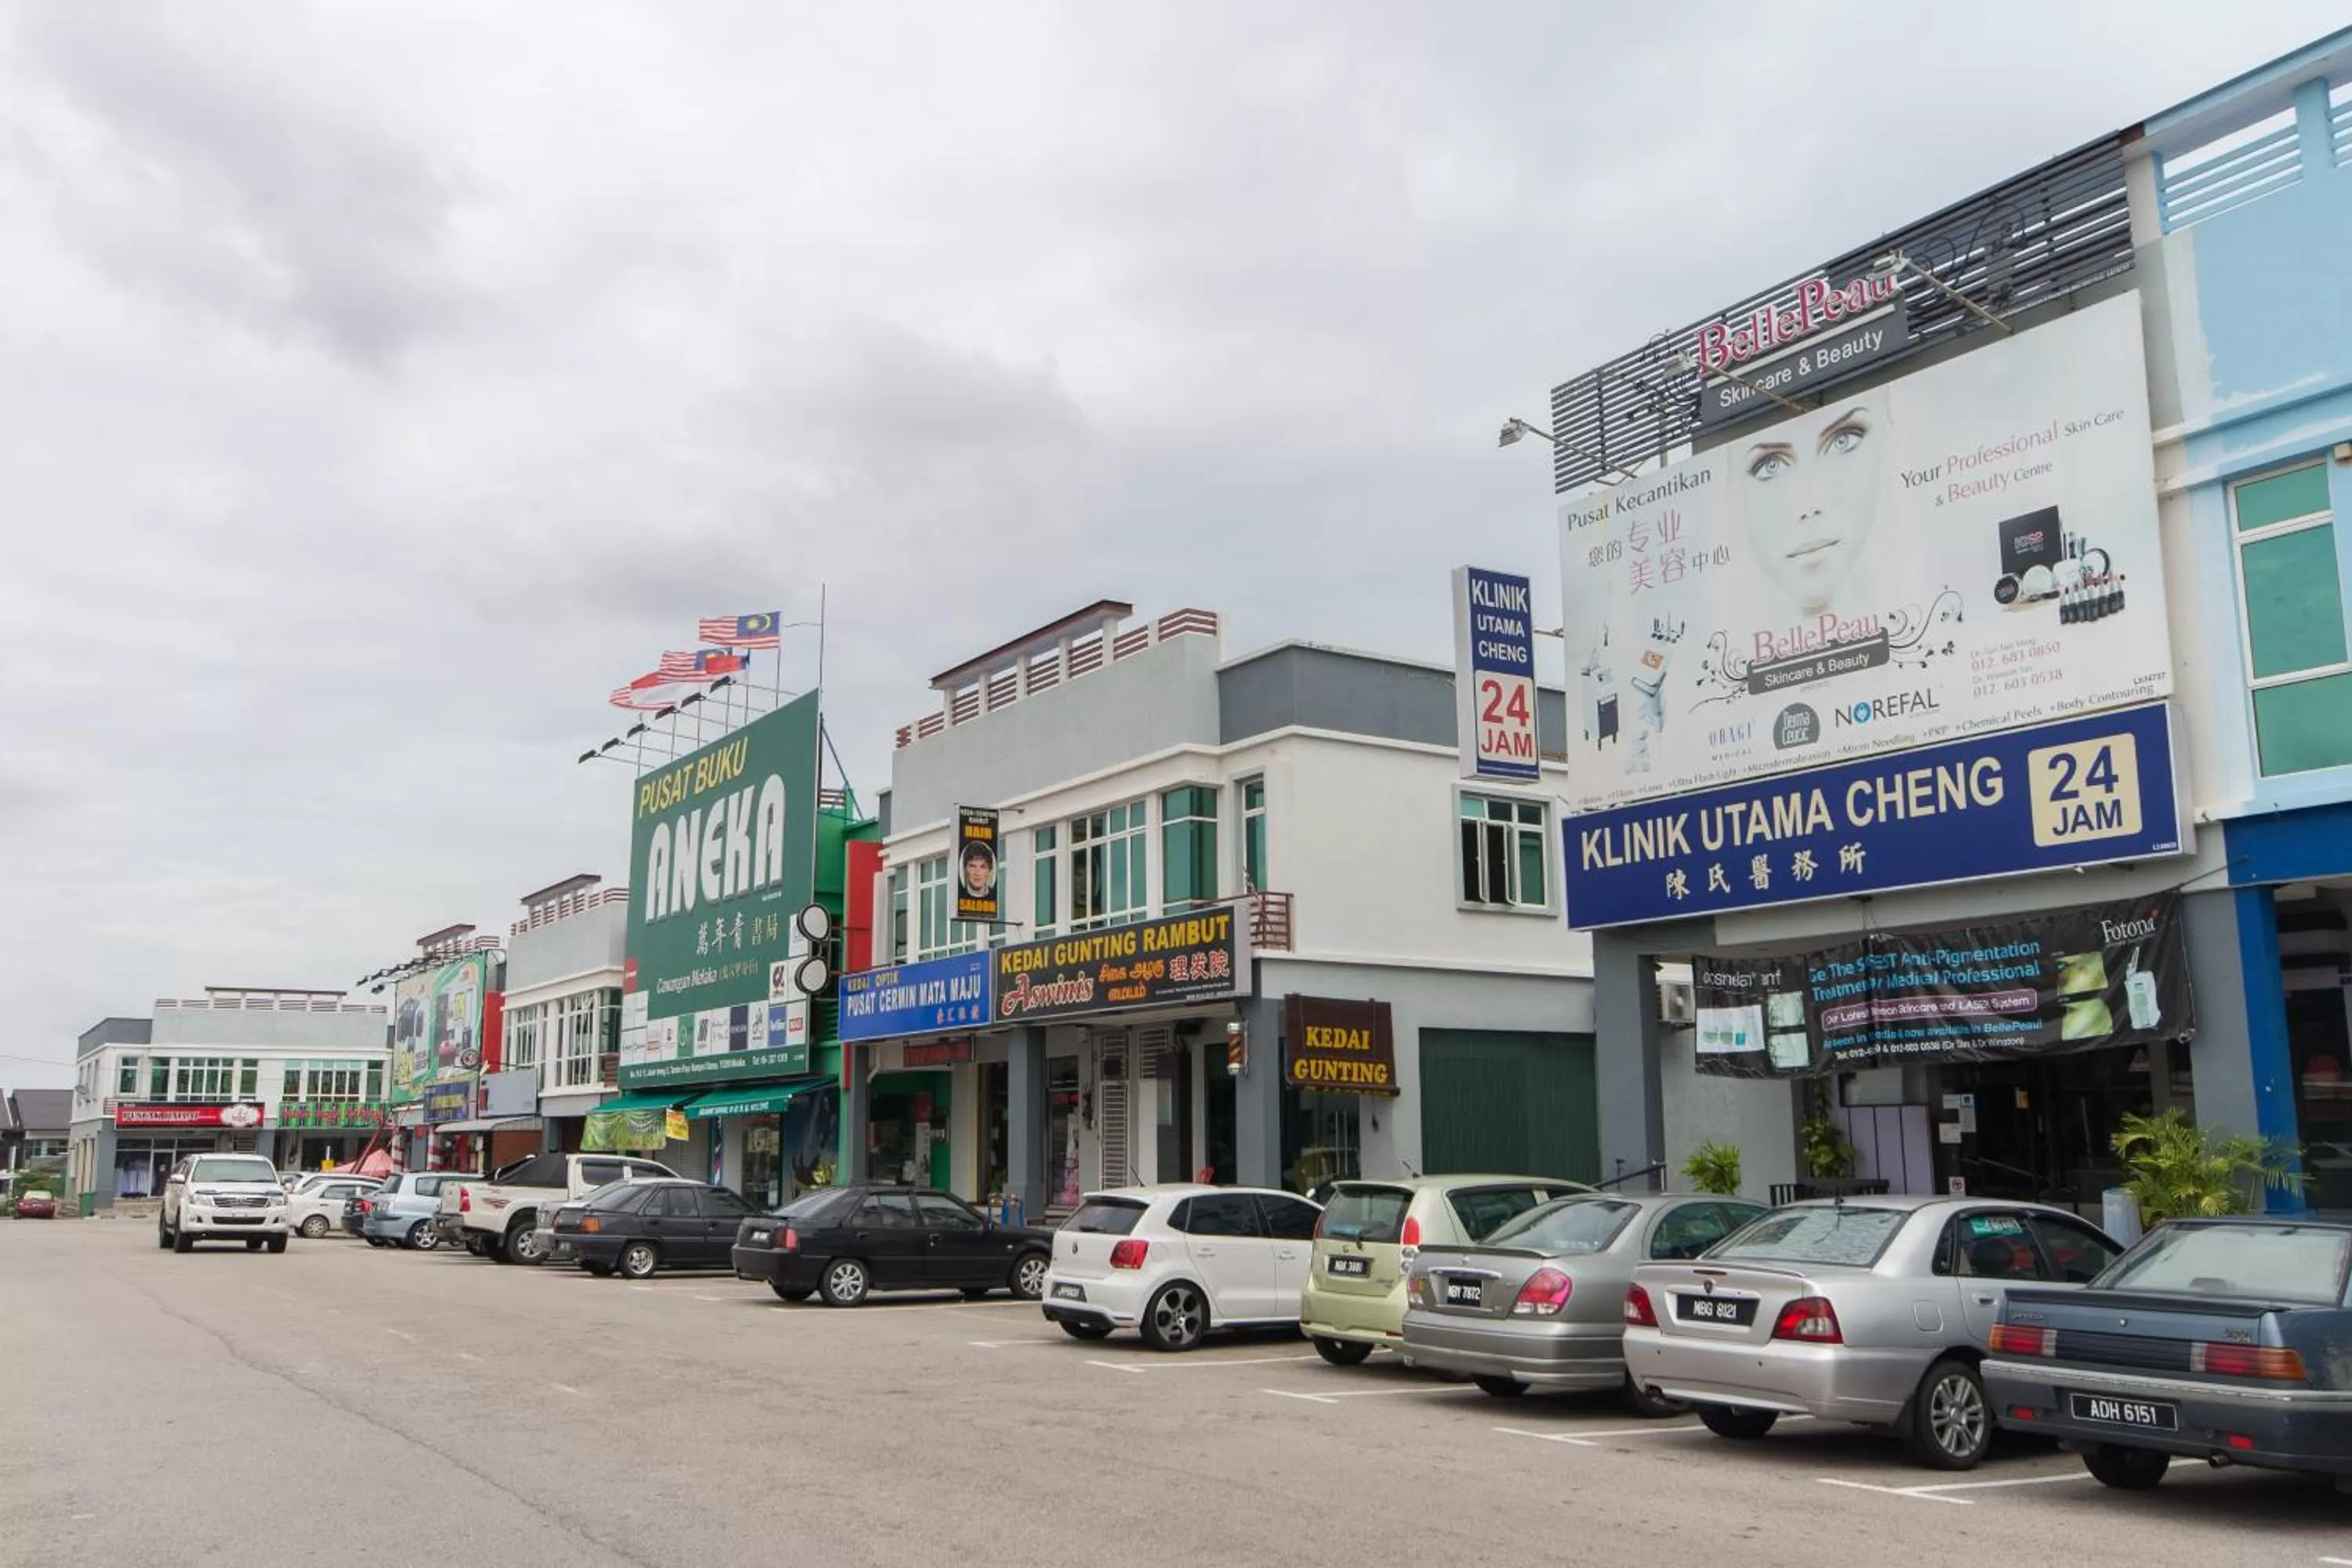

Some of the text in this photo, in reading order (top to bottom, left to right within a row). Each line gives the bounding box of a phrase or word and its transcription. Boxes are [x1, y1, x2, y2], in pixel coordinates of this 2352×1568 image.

[1694, 273, 1897, 377] BellePeau
[1719, 329, 1882, 408] Skincare & Beauty
[1900, 409, 2125, 489] Your Professional Skin Care
[1568, 470, 1711, 531] Pusat Kecantikan
[1935, 461, 2053, 506] & Beauty Centre
[1589, 509, 1686, 567] 您的 专业
[1631, 545, 1730, 595] 美容 中心
[1472, 578, 1528, 612] KLINIK
[1478, 615, 1525, 637] UTAMA
[1752, 614, 1882, 664] BellePeau
[1479, 641, 1527, 662] CHENG
[1765, 666, 1813, 687] Skincare
[1817, 662, 1824, 675] &
[1828, 652, 1870, 672] Beauty
[1481, 680, 1530, 727] 24
[1835, 688, 1940, 728] NOREFAL
[1962, 711, 2010, 732] Chemical
[2014, 706, 2042, 722] Peels
[2057, 699, 2085, 712] Body
[2089, 683, 2154, 706] Contouring
[1481, 729, 1533, 758] JAM
[639, 736, 749, 818] PUSAT BUKU
[2046, 746, 2119, 802] 24
[1582, 757, 2005, 871] KLINIK UTAMA CHENG
[2051, 800, 2124, 837] JAM
[648, 774, 786, 924] ANEKA
[1665, 843, 1867, 899] 陳氏醫務所
[1001, 914, 1230, 974] KEDAI GUNTING RAMBUT
[2101, 916, 2156, 942] Fotona
[656, 977, 691, 994] Cawangan
[691, 967, 717, 986] Melaka
[875, 971, 899, 987] OPTIK
[1169, 949, 1230, 981] 理发院
[1828, 960, 1854, 977] The
[1901, 942, 2040, 967] Anti-Pigmentation
[1887, 972, 1938, 989] Medical
[1944, 961, 2041, 985] Professional
[847, 973, 982, 1017] PUSAT CERMIN MATA MAJU
[1305, 1025, 1370, 1050] KEDAI
[1294, 1058, 1388, 1083] GUNTING
[1693, 1300, 1737, 1319] MBG 8121
[2090, 1399, 2157, 1425] ADH 6151
